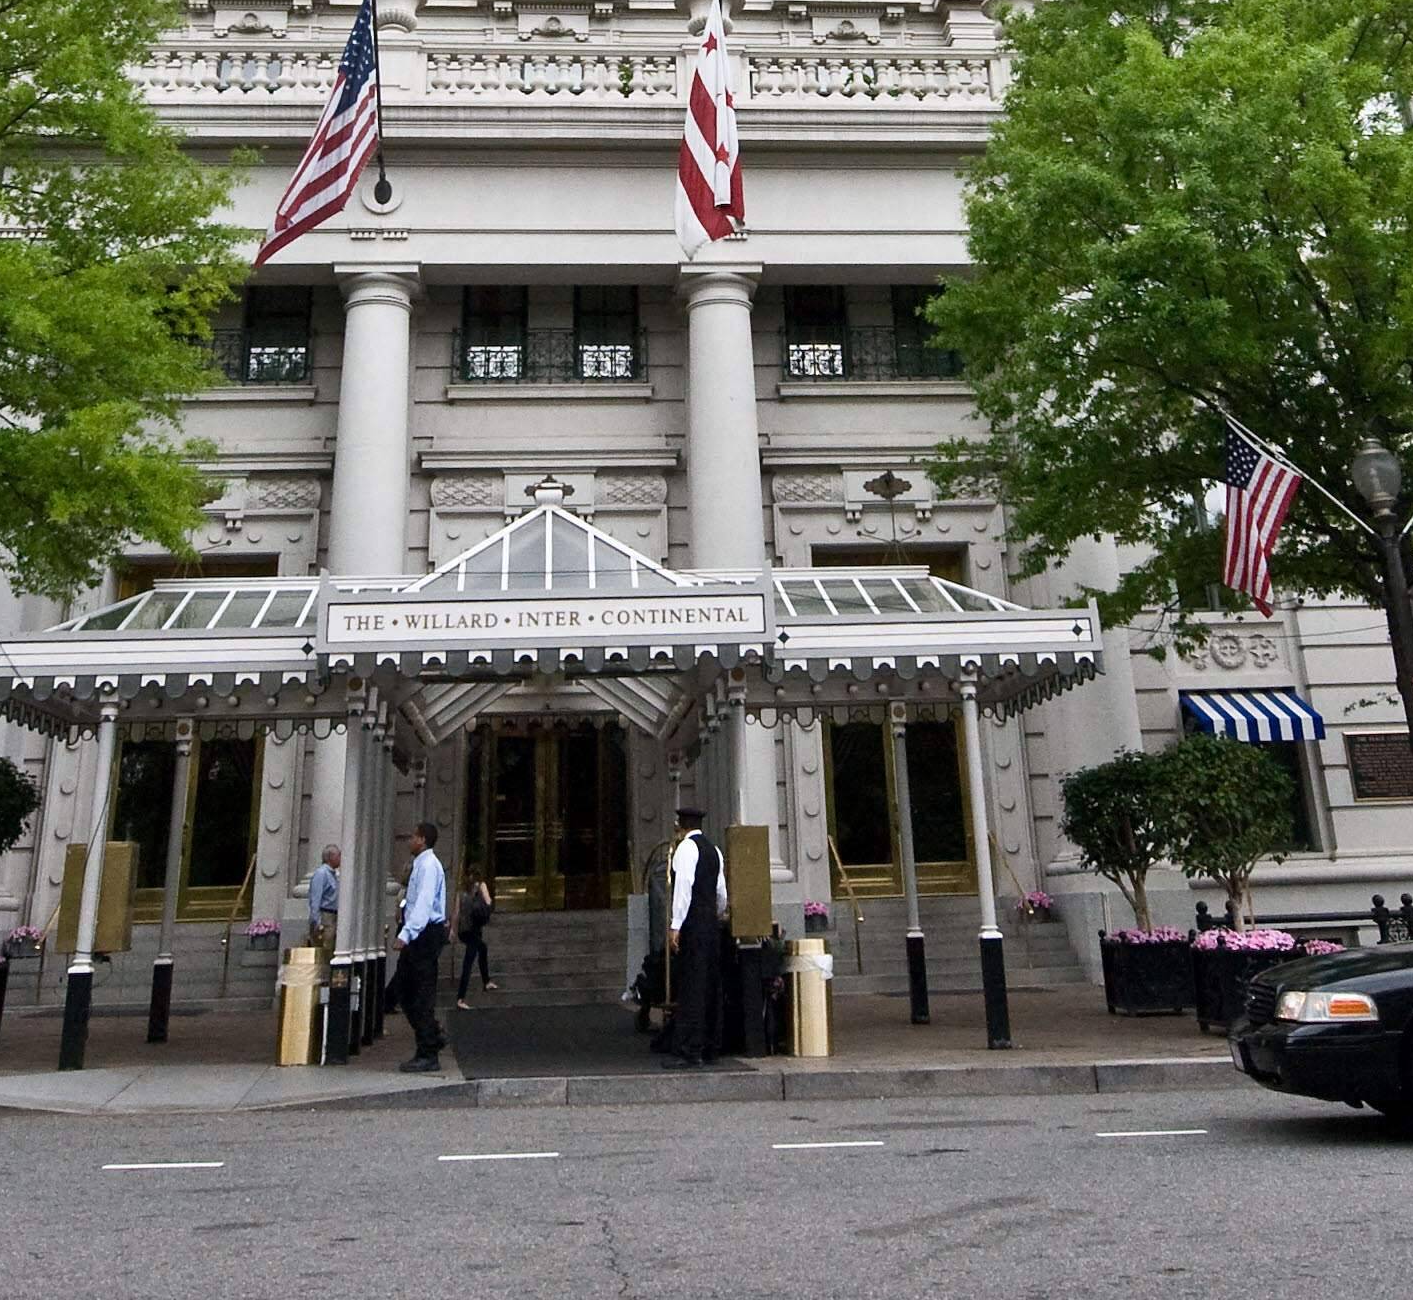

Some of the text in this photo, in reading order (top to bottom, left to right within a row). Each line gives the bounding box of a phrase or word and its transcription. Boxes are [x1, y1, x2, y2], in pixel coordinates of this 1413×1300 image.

[343, 607, 750, 631] THE WILLARD INTER CONTINENTAL
